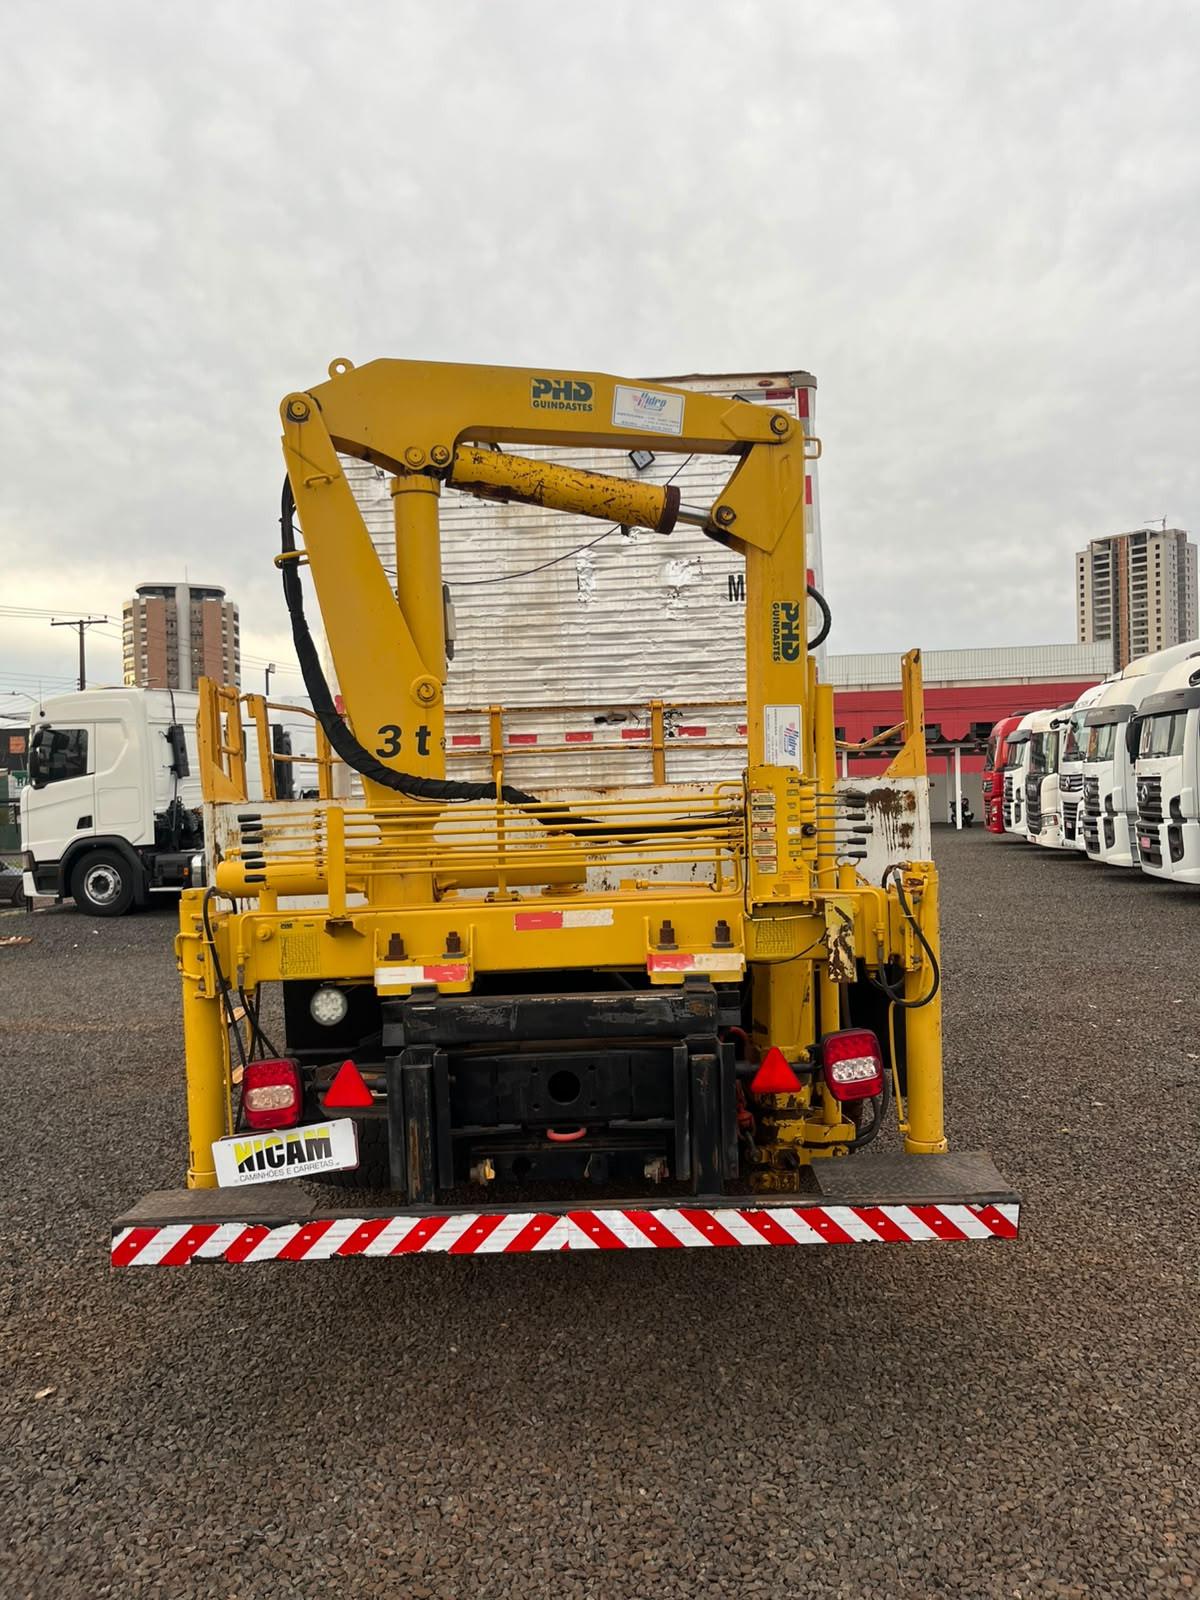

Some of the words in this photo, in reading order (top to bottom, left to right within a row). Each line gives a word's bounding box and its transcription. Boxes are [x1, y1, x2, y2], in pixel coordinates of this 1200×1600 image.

[532, 378, 593, 402] PHD
[532, 400, 593, 412] GUINDASTES
[772, 602, 781, 662] GUINDASTES
[781, 602, 800, 662] PHD
[375, 724, 403, 759] 3
[415, 725, 432, 756] t
[233, 1126, 333, 1174] NICAM
[286, 1167, 292, 1175] E
[293, 1159, 334, 1174] CARRETAS
